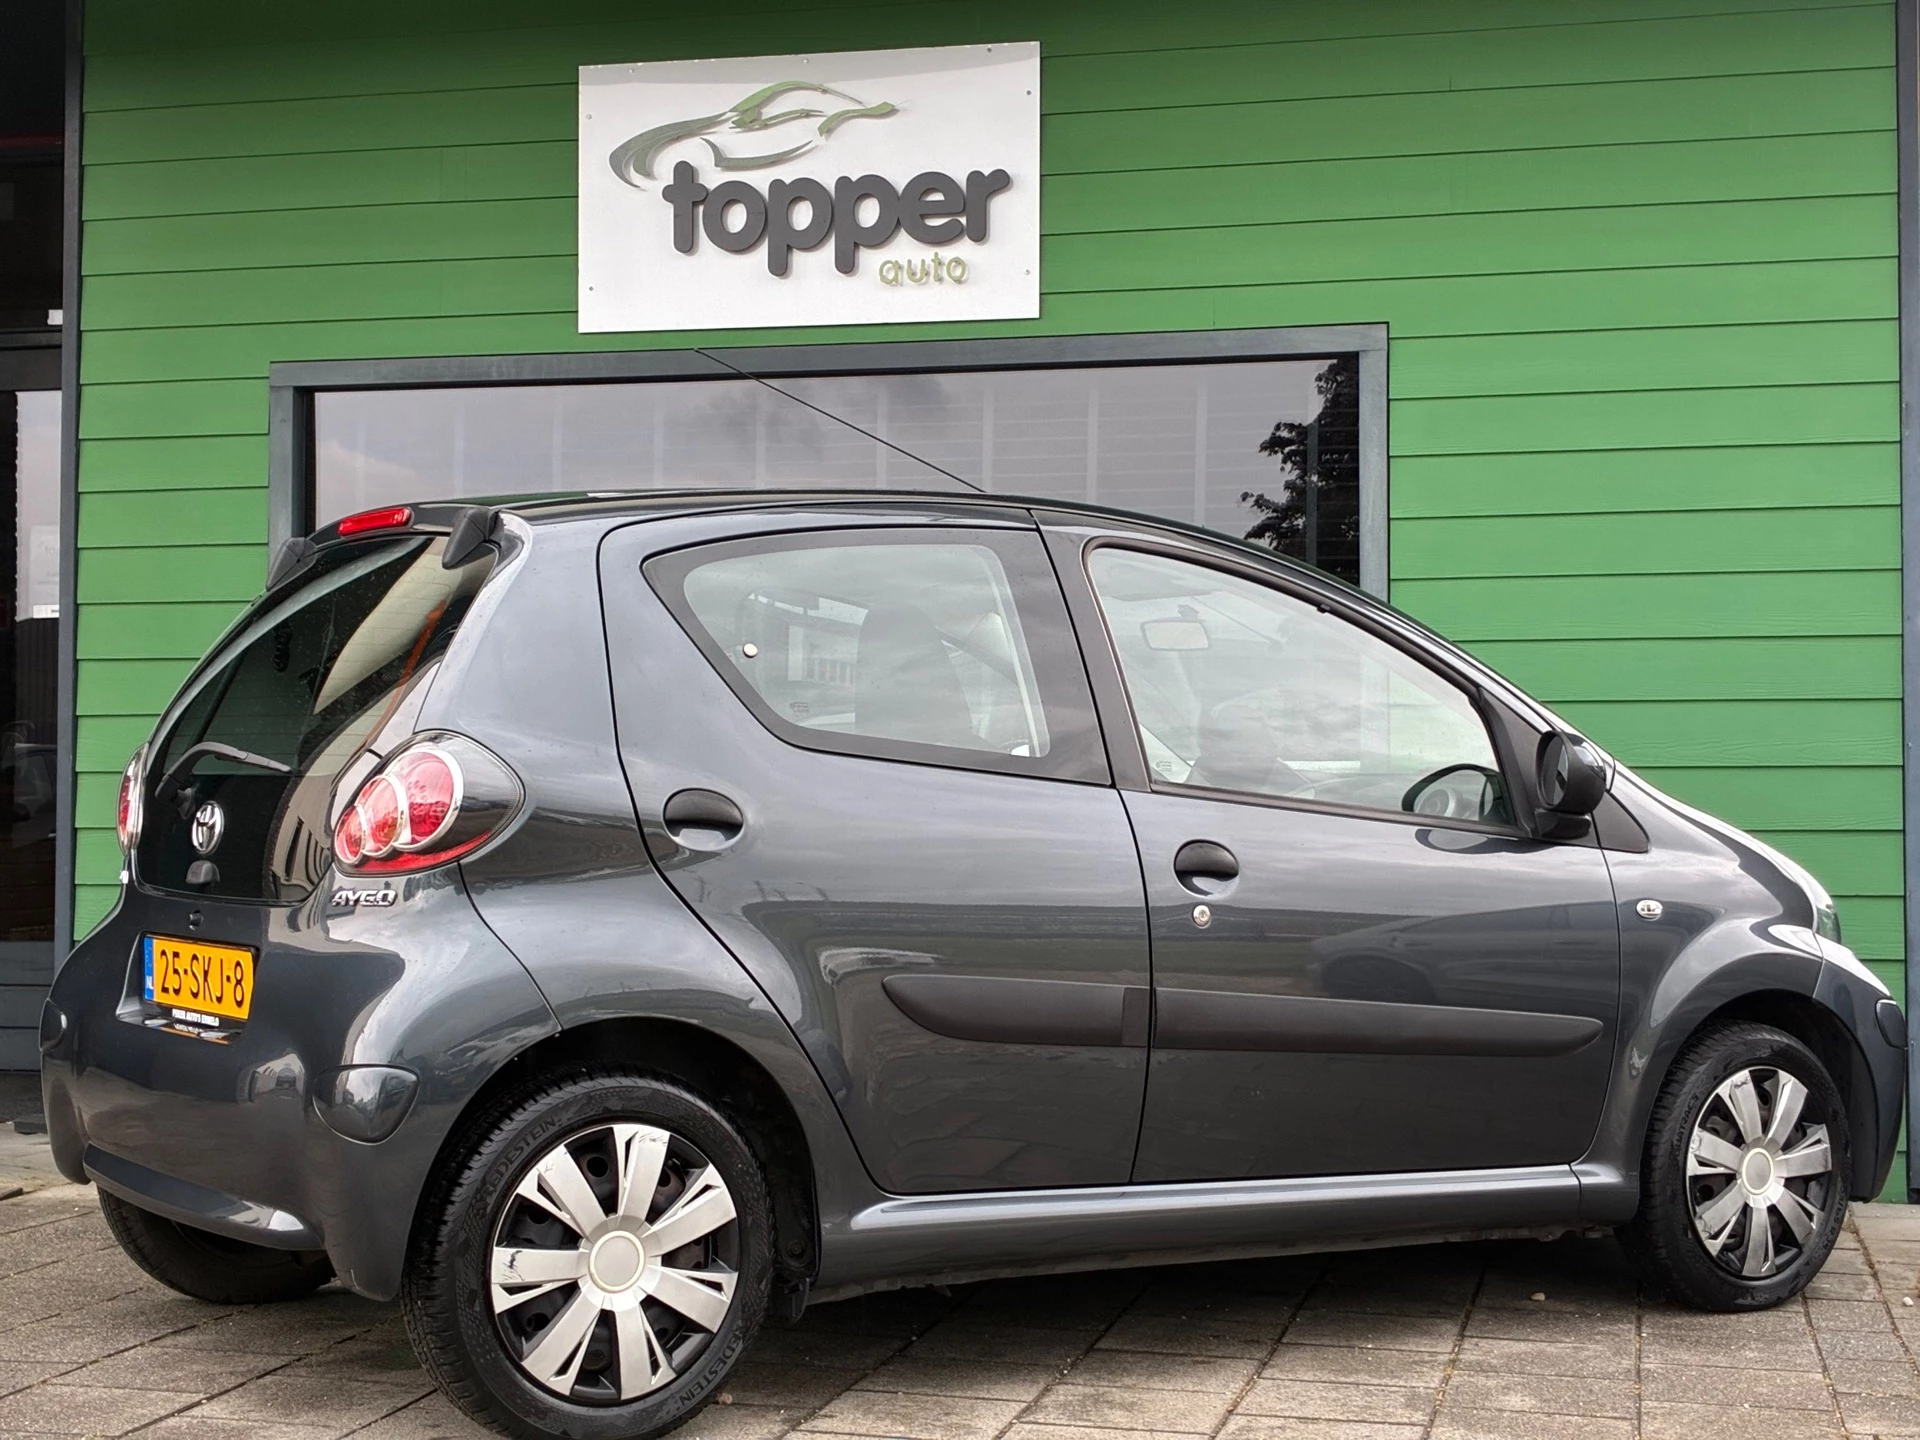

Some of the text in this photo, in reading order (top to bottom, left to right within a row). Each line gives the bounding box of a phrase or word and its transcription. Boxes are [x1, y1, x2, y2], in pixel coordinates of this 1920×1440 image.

[662, 160, 1013, 277] topper
[879, 252, 968, 286] auto
[331, 889, 397, 907] AYGO
[160, 949, 244, 1008] 25-SKJ-8
